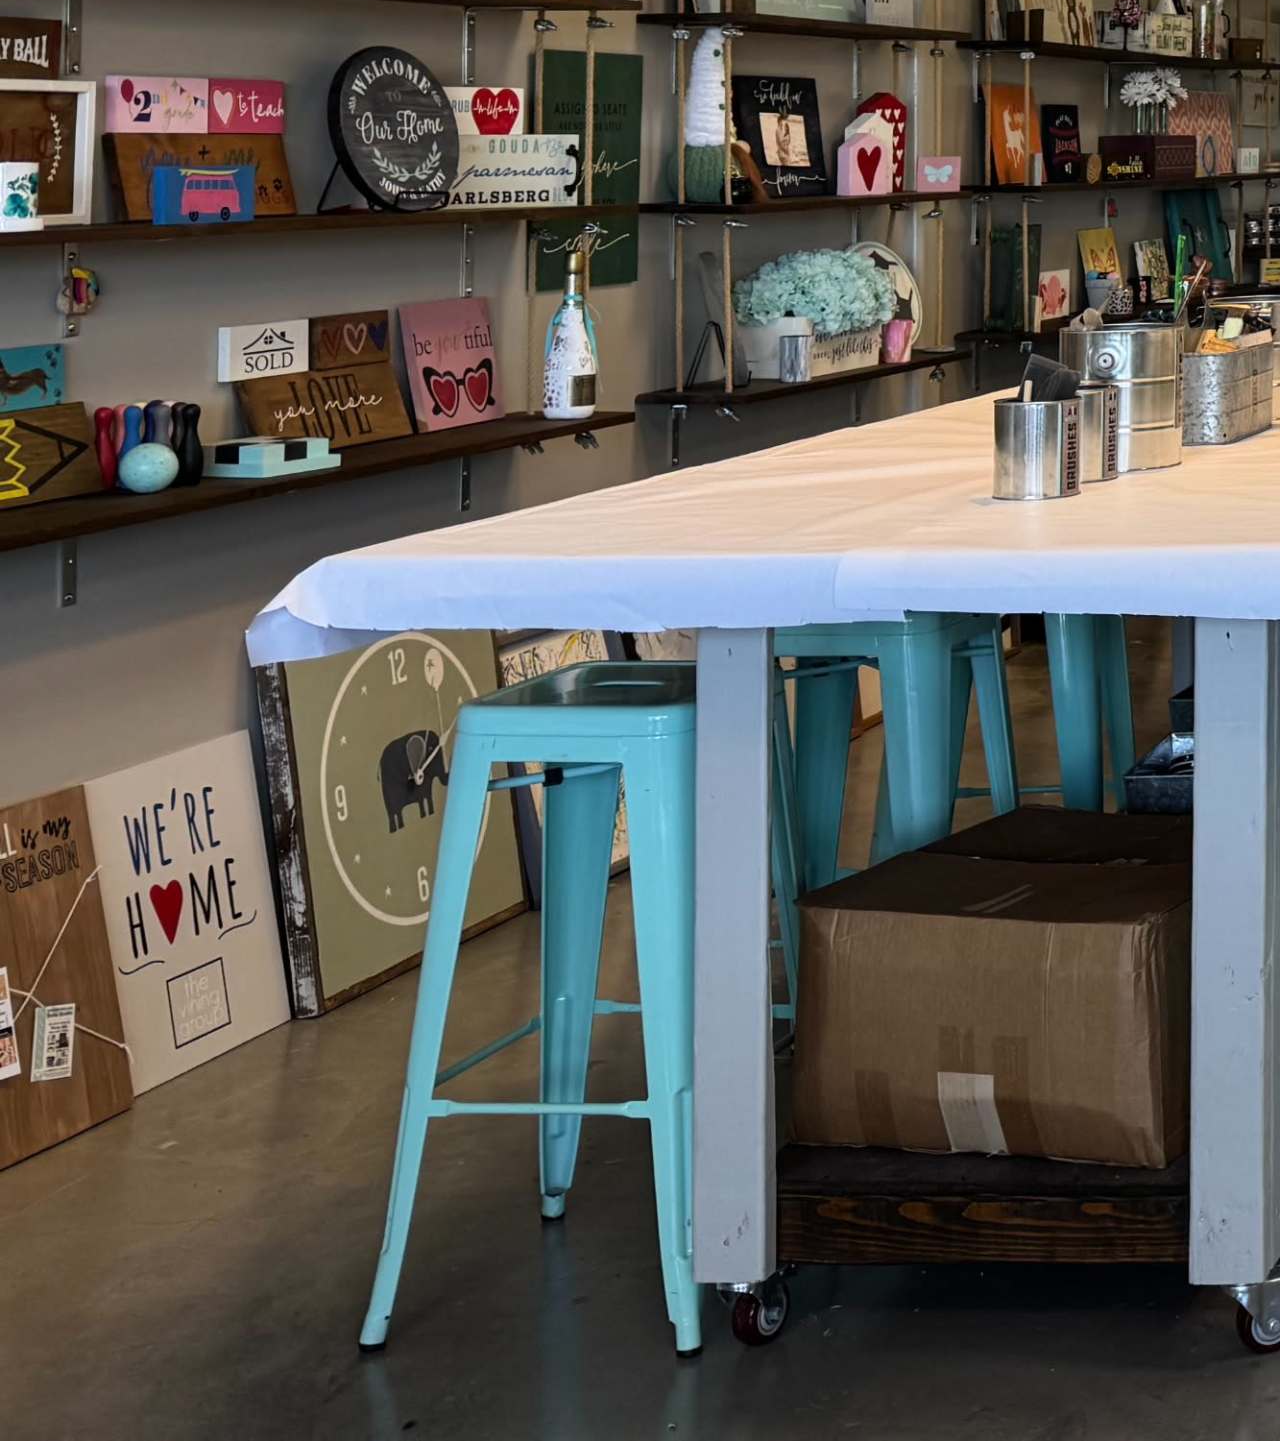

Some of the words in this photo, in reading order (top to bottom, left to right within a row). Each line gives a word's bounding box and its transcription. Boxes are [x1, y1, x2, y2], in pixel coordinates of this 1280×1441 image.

[14, 34, 49, 69] BALL
[351, 55, 431, 98] WELCOME
[247, 90, 285, 123] teach
[486, 97, 505, 119] life
[355, 111, 393, 145] Our
[396, 109, 444, 145] Home
[488, 138, 541, 156] GOUDA
[451, 163, 574, 192] parmesan
[243, 351, 295, 375] SOLD
[413, 333, 433, 359] be
[273, 403, 316, 433] you
[324, 393, 383, 417] more
[288, 374, 373, 439] LOVE
[1066, 421, 1079, 491] BRUSHES
[1107, 407, 1118, 473] BRUSHES
[385, 647, 409, 686] 12
[334, 785, 349, 821] 9
[20, 826, 40, 850] is
[41, 815, 72, 841] my
[123, 785, 221, 877] WE'RE
[1, 839, 81, 894] SEASON
[416, 866, 430, 902] 6
